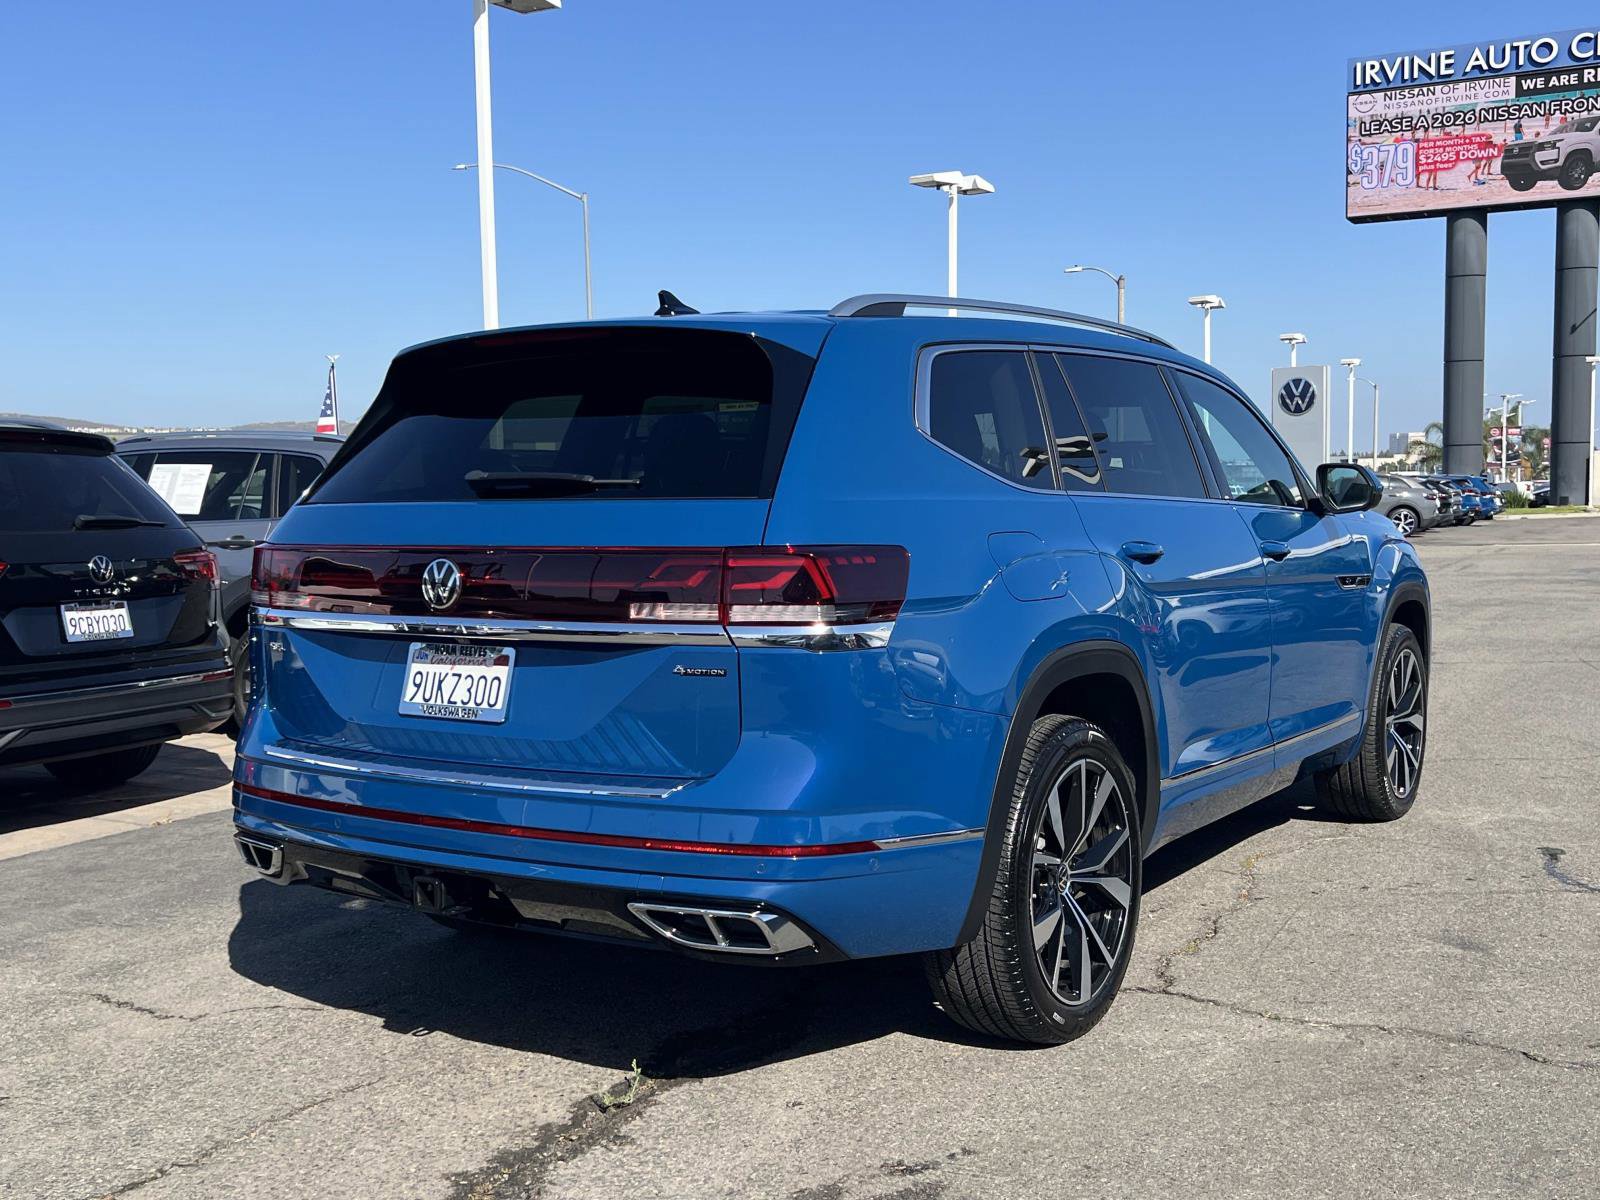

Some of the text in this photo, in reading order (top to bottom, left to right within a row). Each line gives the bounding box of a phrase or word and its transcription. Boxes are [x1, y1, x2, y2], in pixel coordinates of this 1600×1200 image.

[1355, 31, 1600, 86] IRVINE AUTO C
[1383, 76, 1512, 102] NISSAN OF IRVINE
[1521, 77, 1545, 90] WE
[1548, 73, 1579, 88] ARE
[1383, 89, 1510, 110] NISSANOFIRVINE.COM
[1360, 95, 1600, 136] LEASE A 2026 NISSAN FRON
[1418, 141, 1435, 149] PER
[1435, 138, 1465, 147] MONTH
[1471, 135, 1487, 143] TAX
[1445, 144, 1480, 152] MONTHS
[1350, 142, 1414, 190] $379
[1418, 147, 1499, 165] $2495 DOWN
[69, 614, 126, 636] 9CBY030
[434, 643, 488, 658] NORM REEVES
[409, 670, 502, 708] 9UKZ300
[421, 703, 479, 719] VOLKSWAGEN
